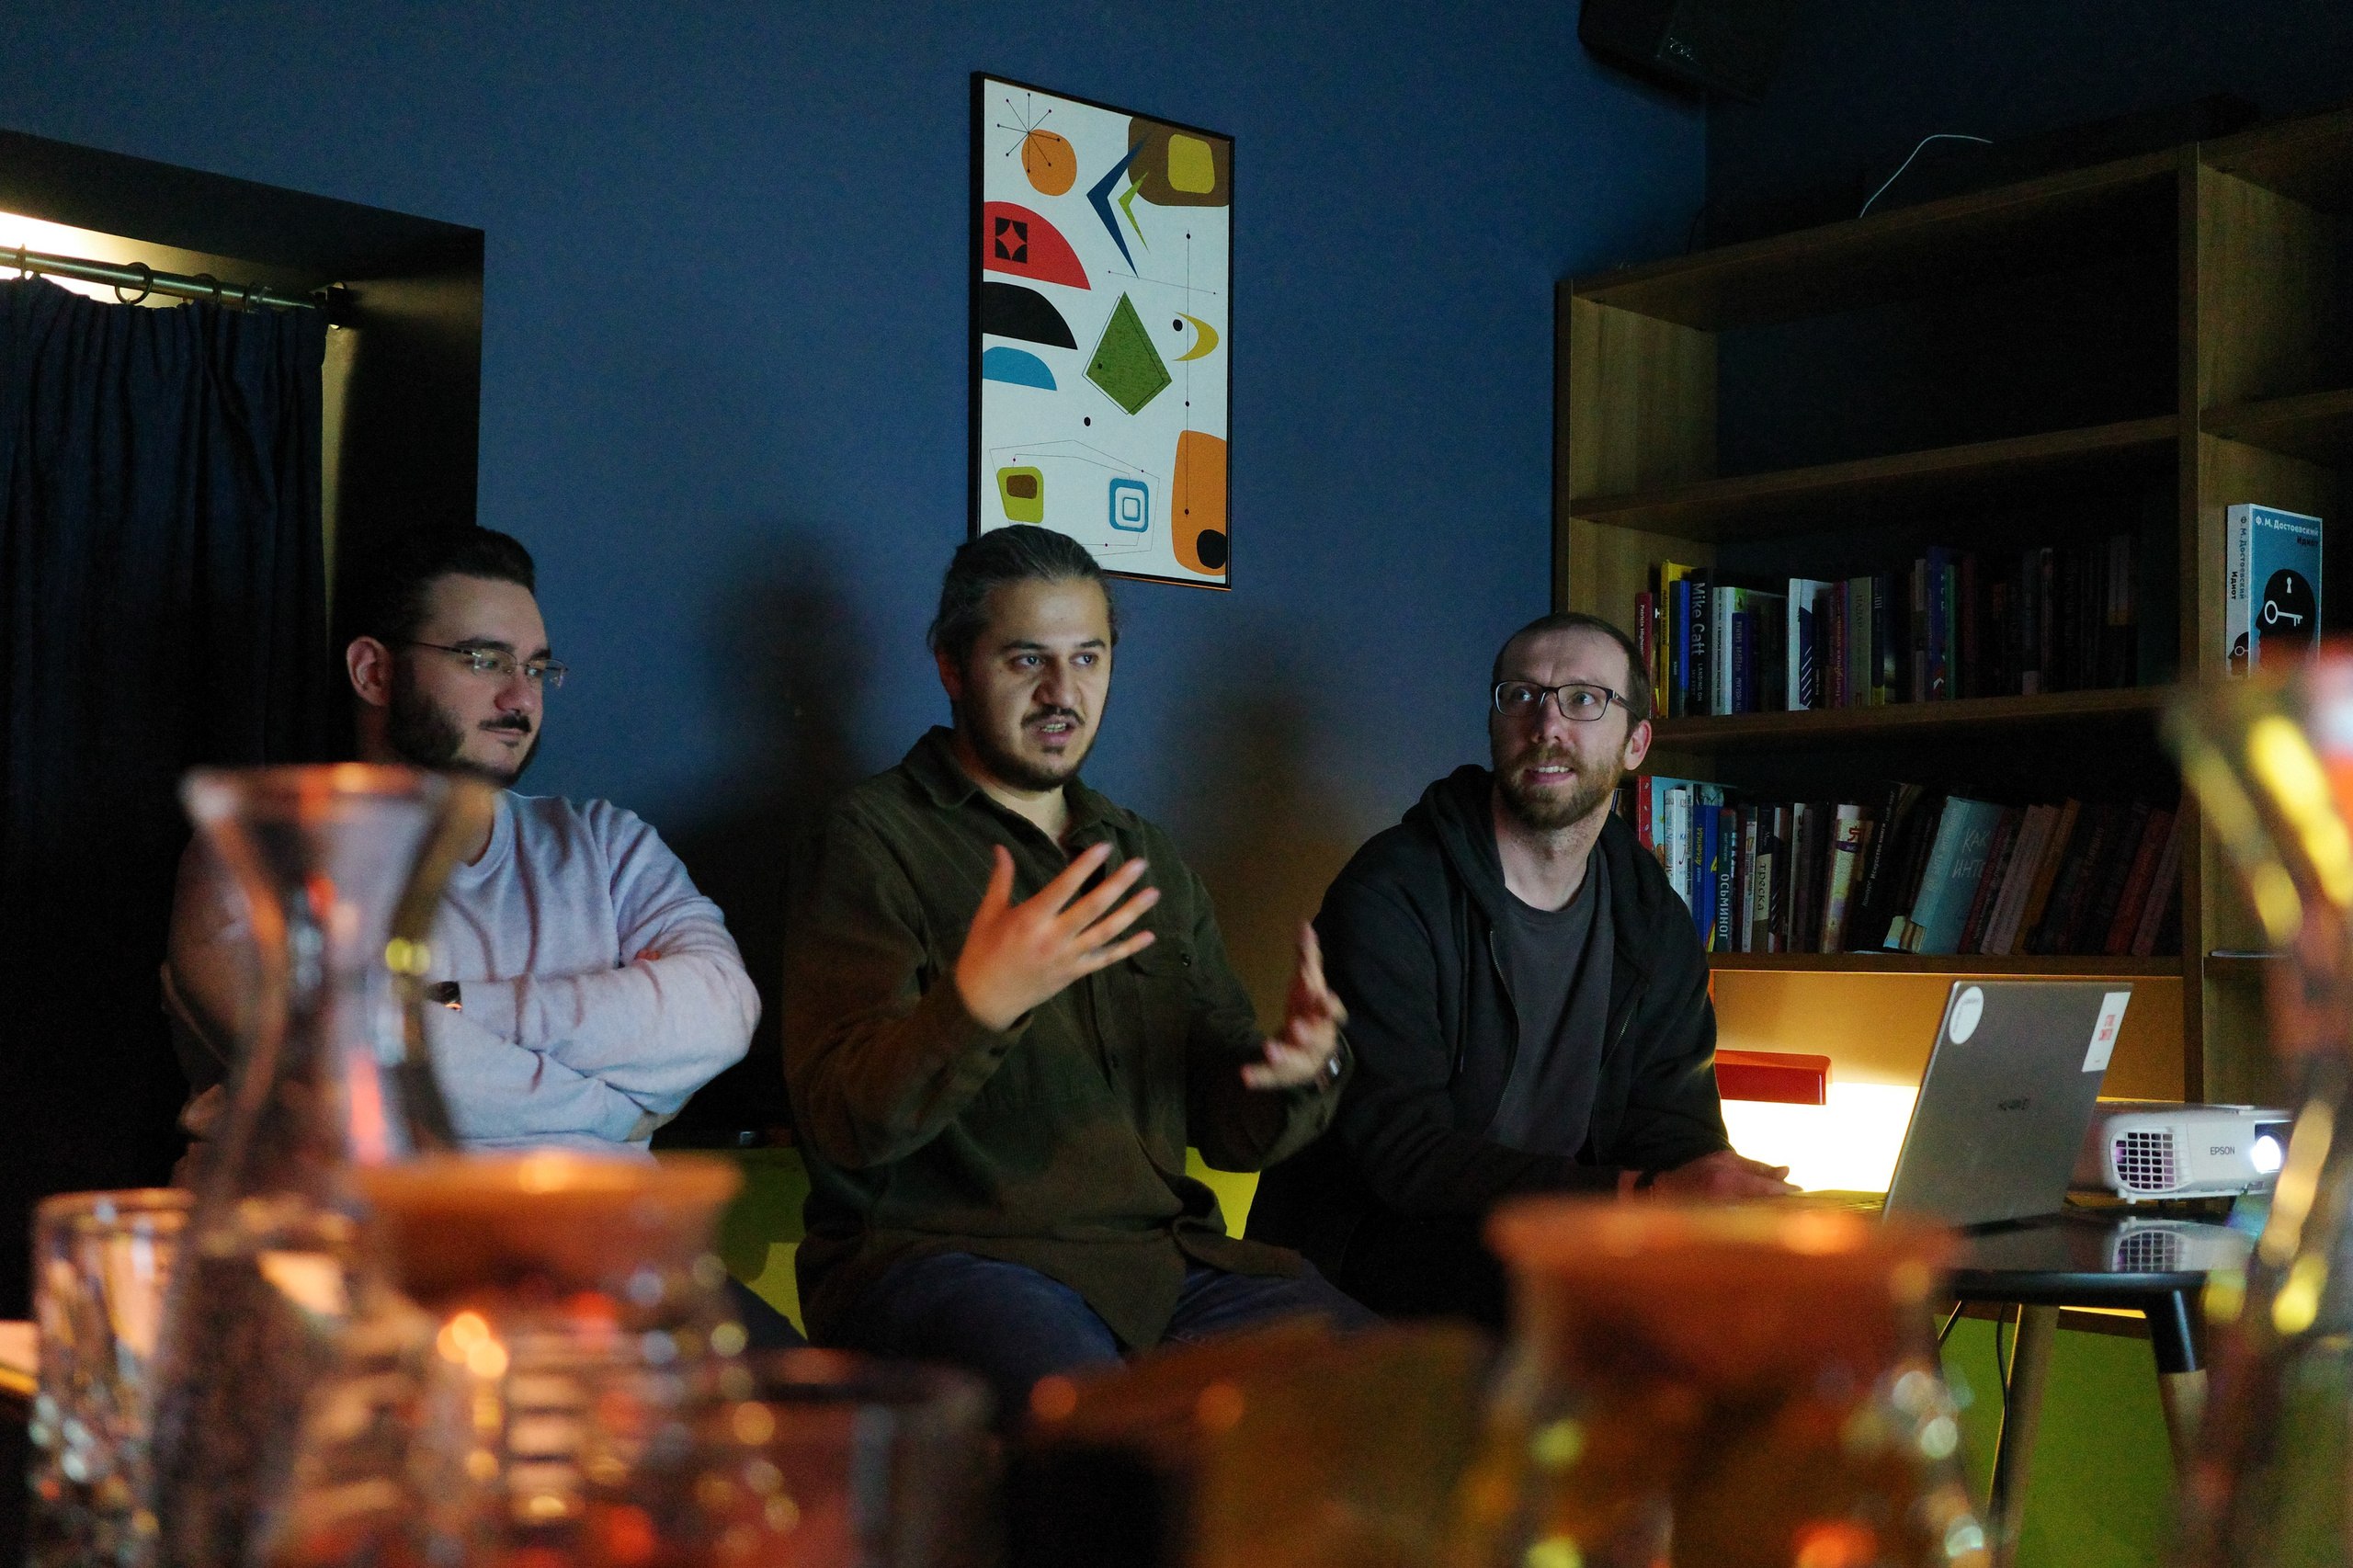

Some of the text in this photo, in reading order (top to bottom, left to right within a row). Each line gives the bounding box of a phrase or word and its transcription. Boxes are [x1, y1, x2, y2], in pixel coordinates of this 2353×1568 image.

[2255, 515, 2319, 537] Ф. М. Достоевский
[2239, 516, 2247, 599] Ф. М. Достоевский
[2296, 537, 2319, 548] Идиот
[2229, 571, 2238, 600] Идиот
[1690, 582, 1706, 656] Mike Catt
[1697, 691, 1703, 701] ON
[1870, 843, 1882, 879] Искусство
[1757, 863, 1767, 912] треска
[1719, 873, 1729, 939] ОСЬМИНОГ
[2210, 1146, 2235, 1155] EPSON
